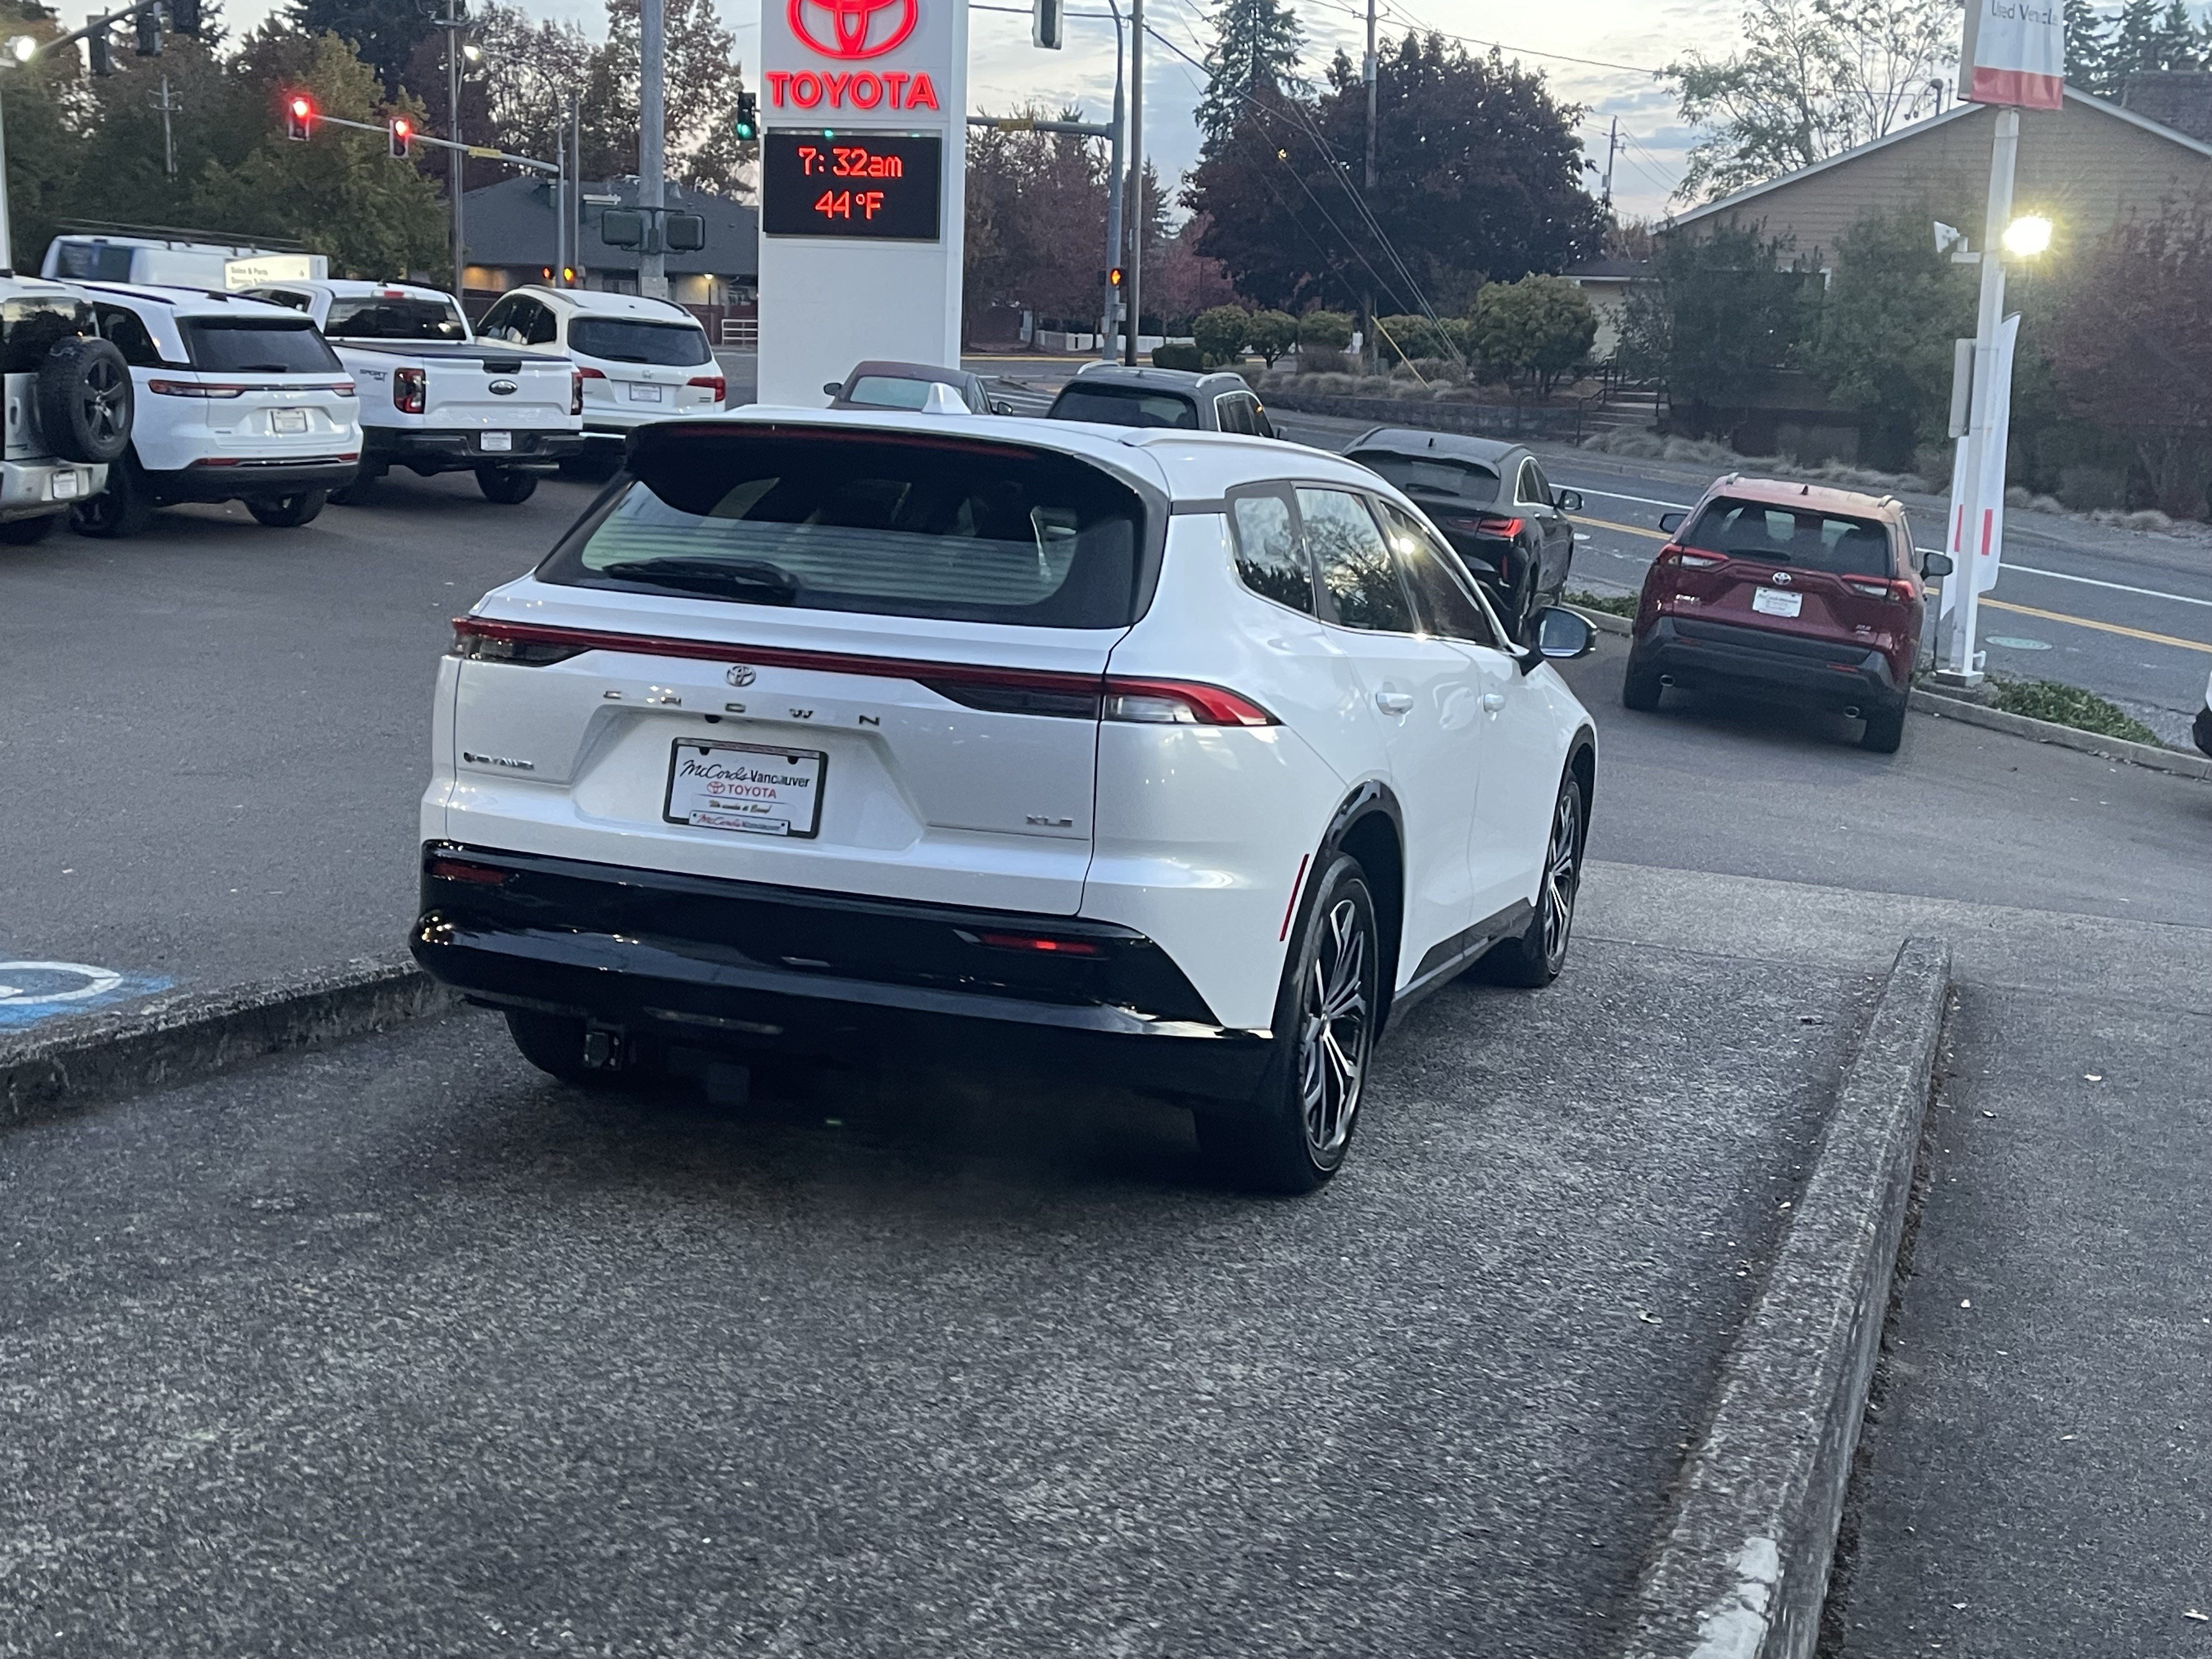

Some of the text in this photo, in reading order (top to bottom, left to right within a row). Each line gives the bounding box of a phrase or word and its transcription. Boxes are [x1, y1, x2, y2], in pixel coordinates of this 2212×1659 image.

[766, 70, 939, 109] TOYOTA
[815, 190, 885, 219] 44°F
[603, 689, 881, 726] CROWN
[727, 784, 777, 799] TOYOTA
